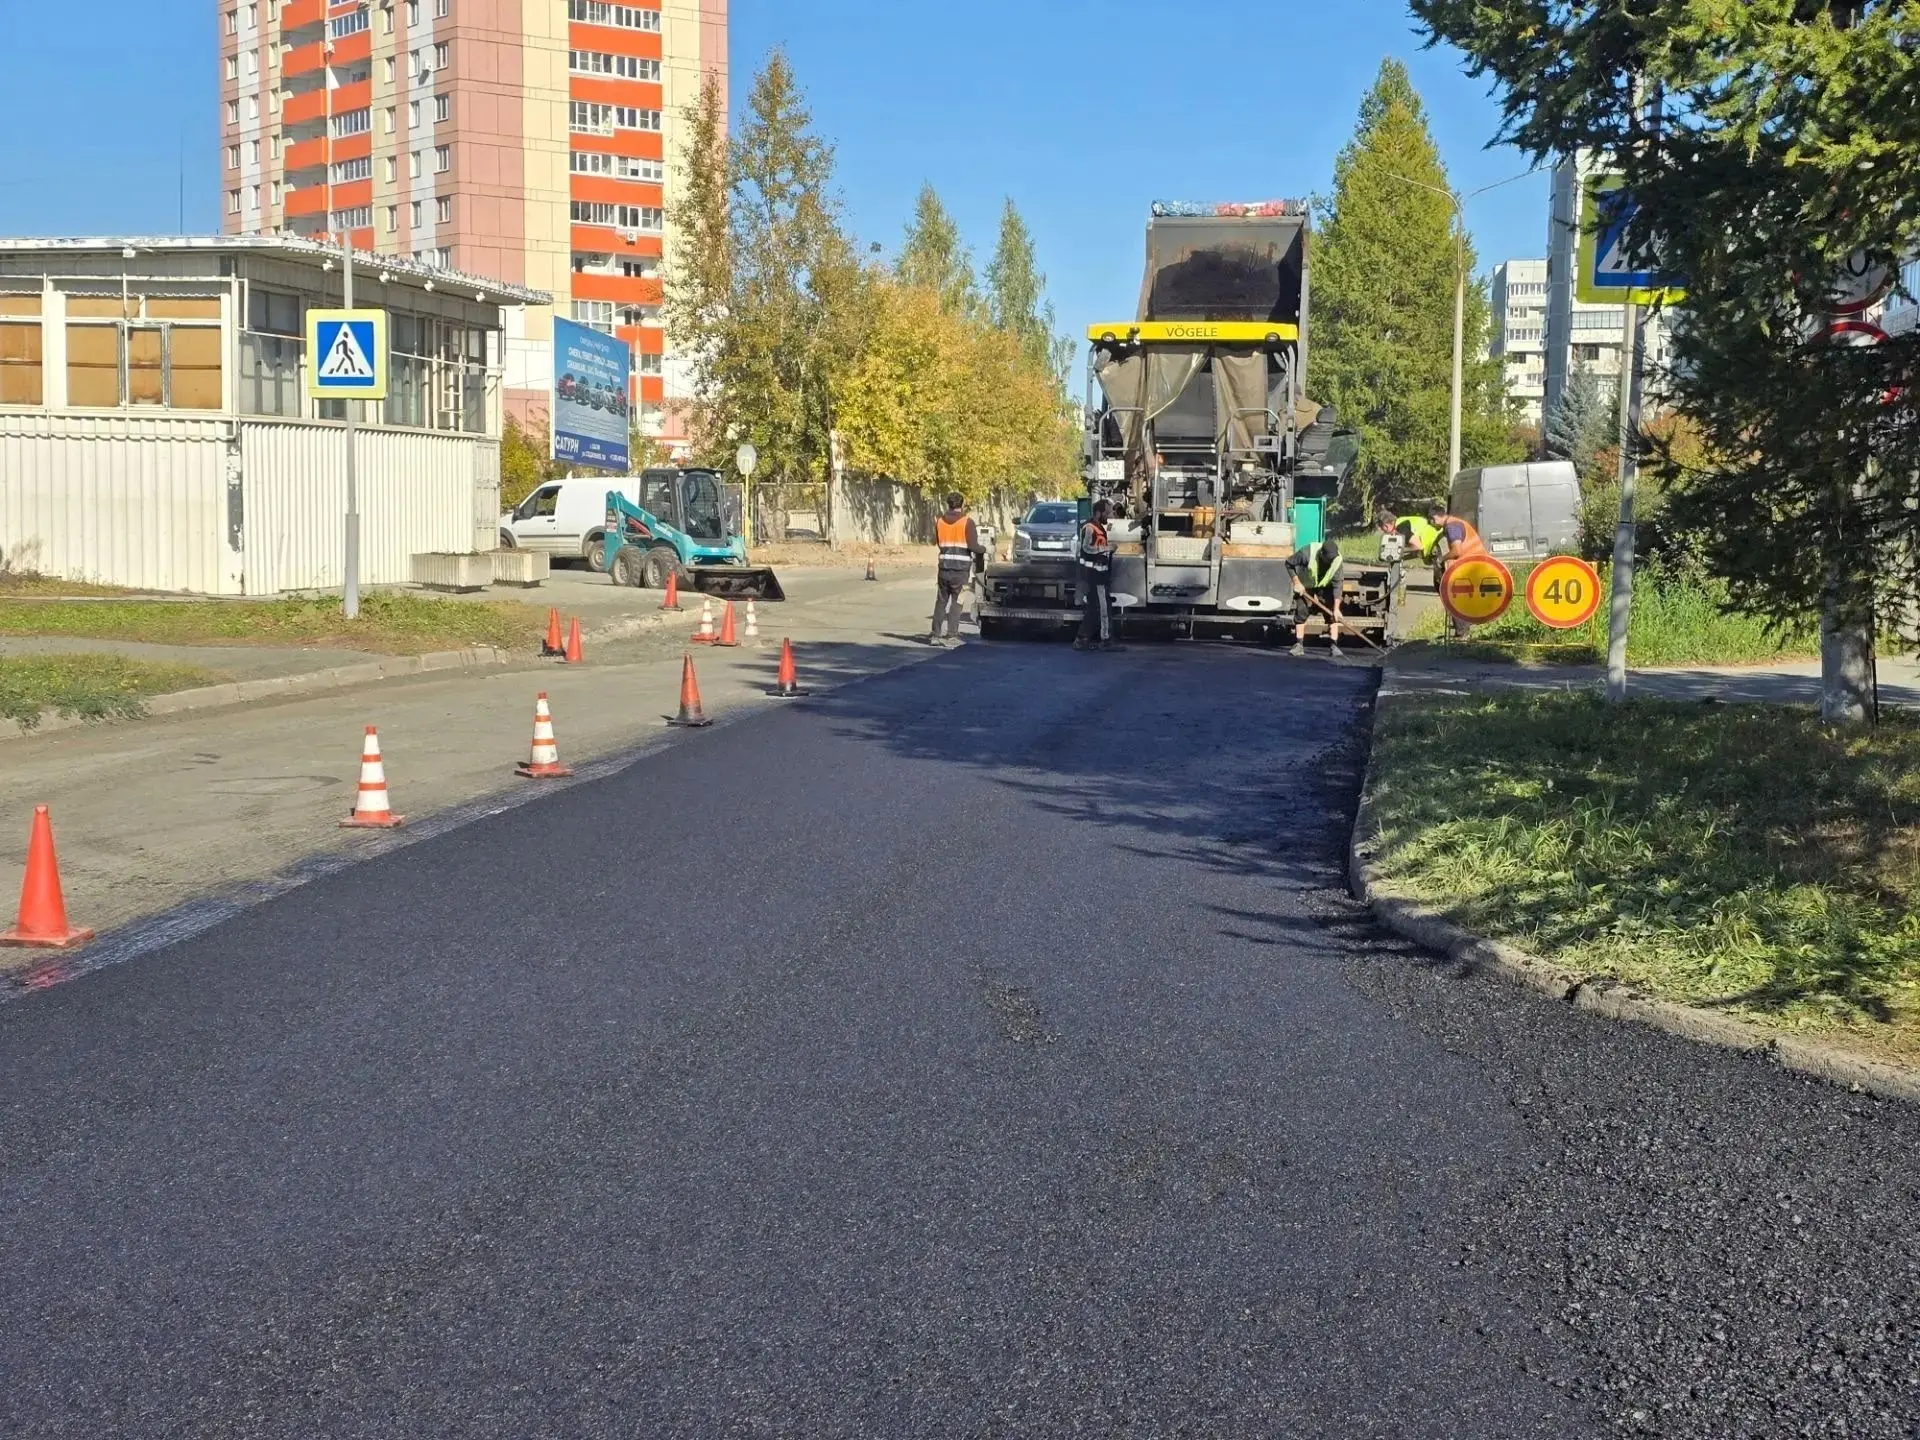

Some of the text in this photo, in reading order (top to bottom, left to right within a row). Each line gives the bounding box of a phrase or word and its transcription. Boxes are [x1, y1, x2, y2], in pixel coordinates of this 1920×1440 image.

[1166, 324, 1218, 337] VÖGELE
[555, 435, 579, 452] САТУРН
[1543, 578, 1582, 605] 40
